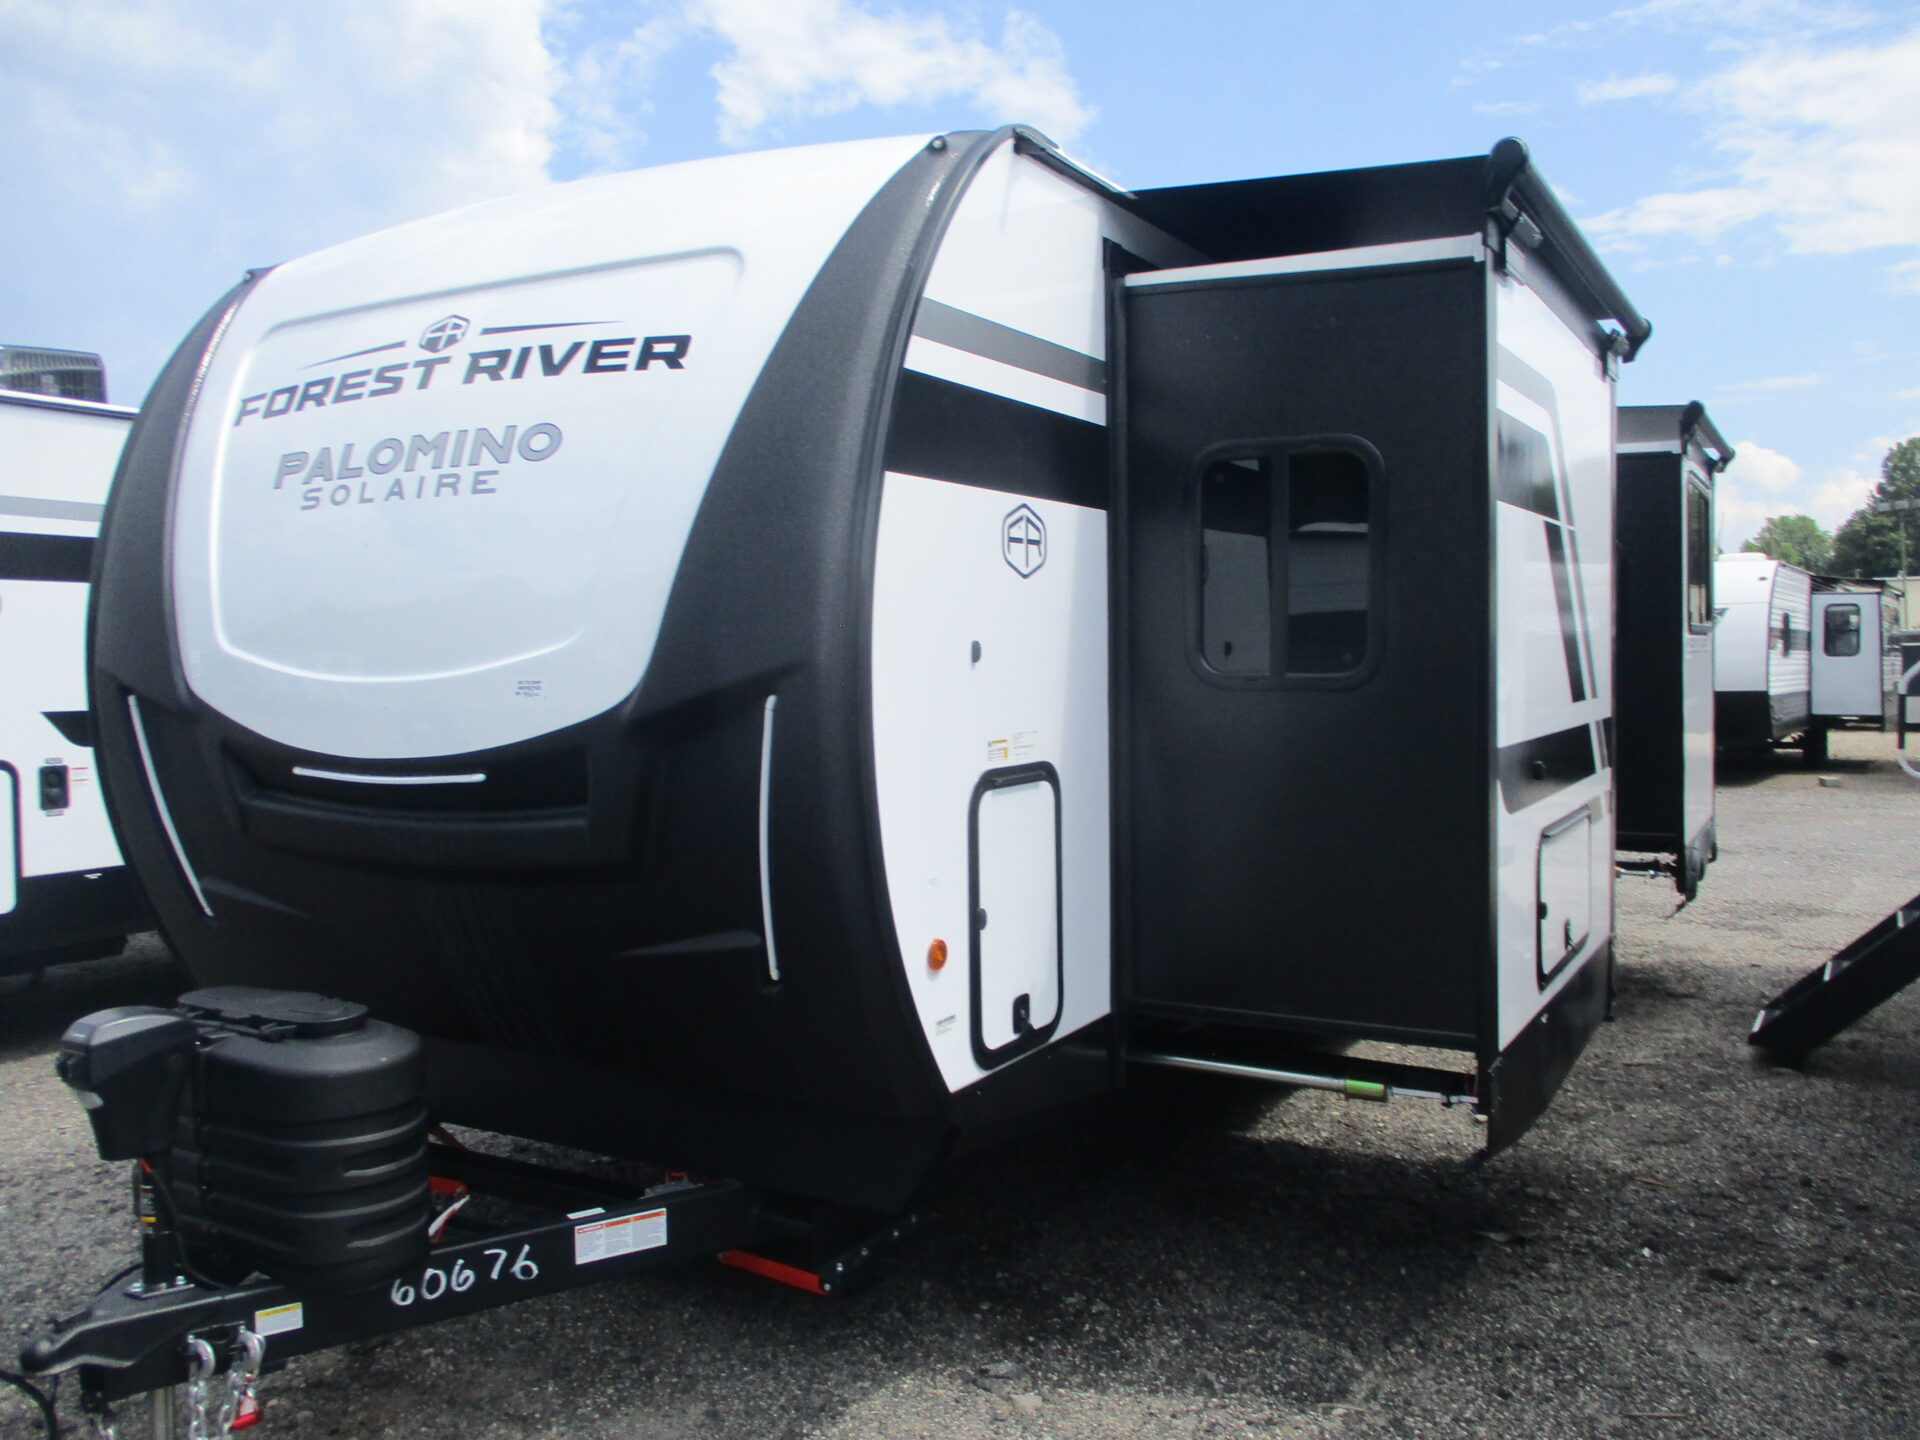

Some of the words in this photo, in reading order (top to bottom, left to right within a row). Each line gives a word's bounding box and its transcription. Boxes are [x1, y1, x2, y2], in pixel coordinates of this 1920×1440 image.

[235, 356, 451, 427] FOREST
[462, 334, 693, 385] RIVER
[273, 422, 564, 490] PALOMINO
[300, 470, 500, 511] SOLAIRE
[390, 1243, 540, 1306] 60676
